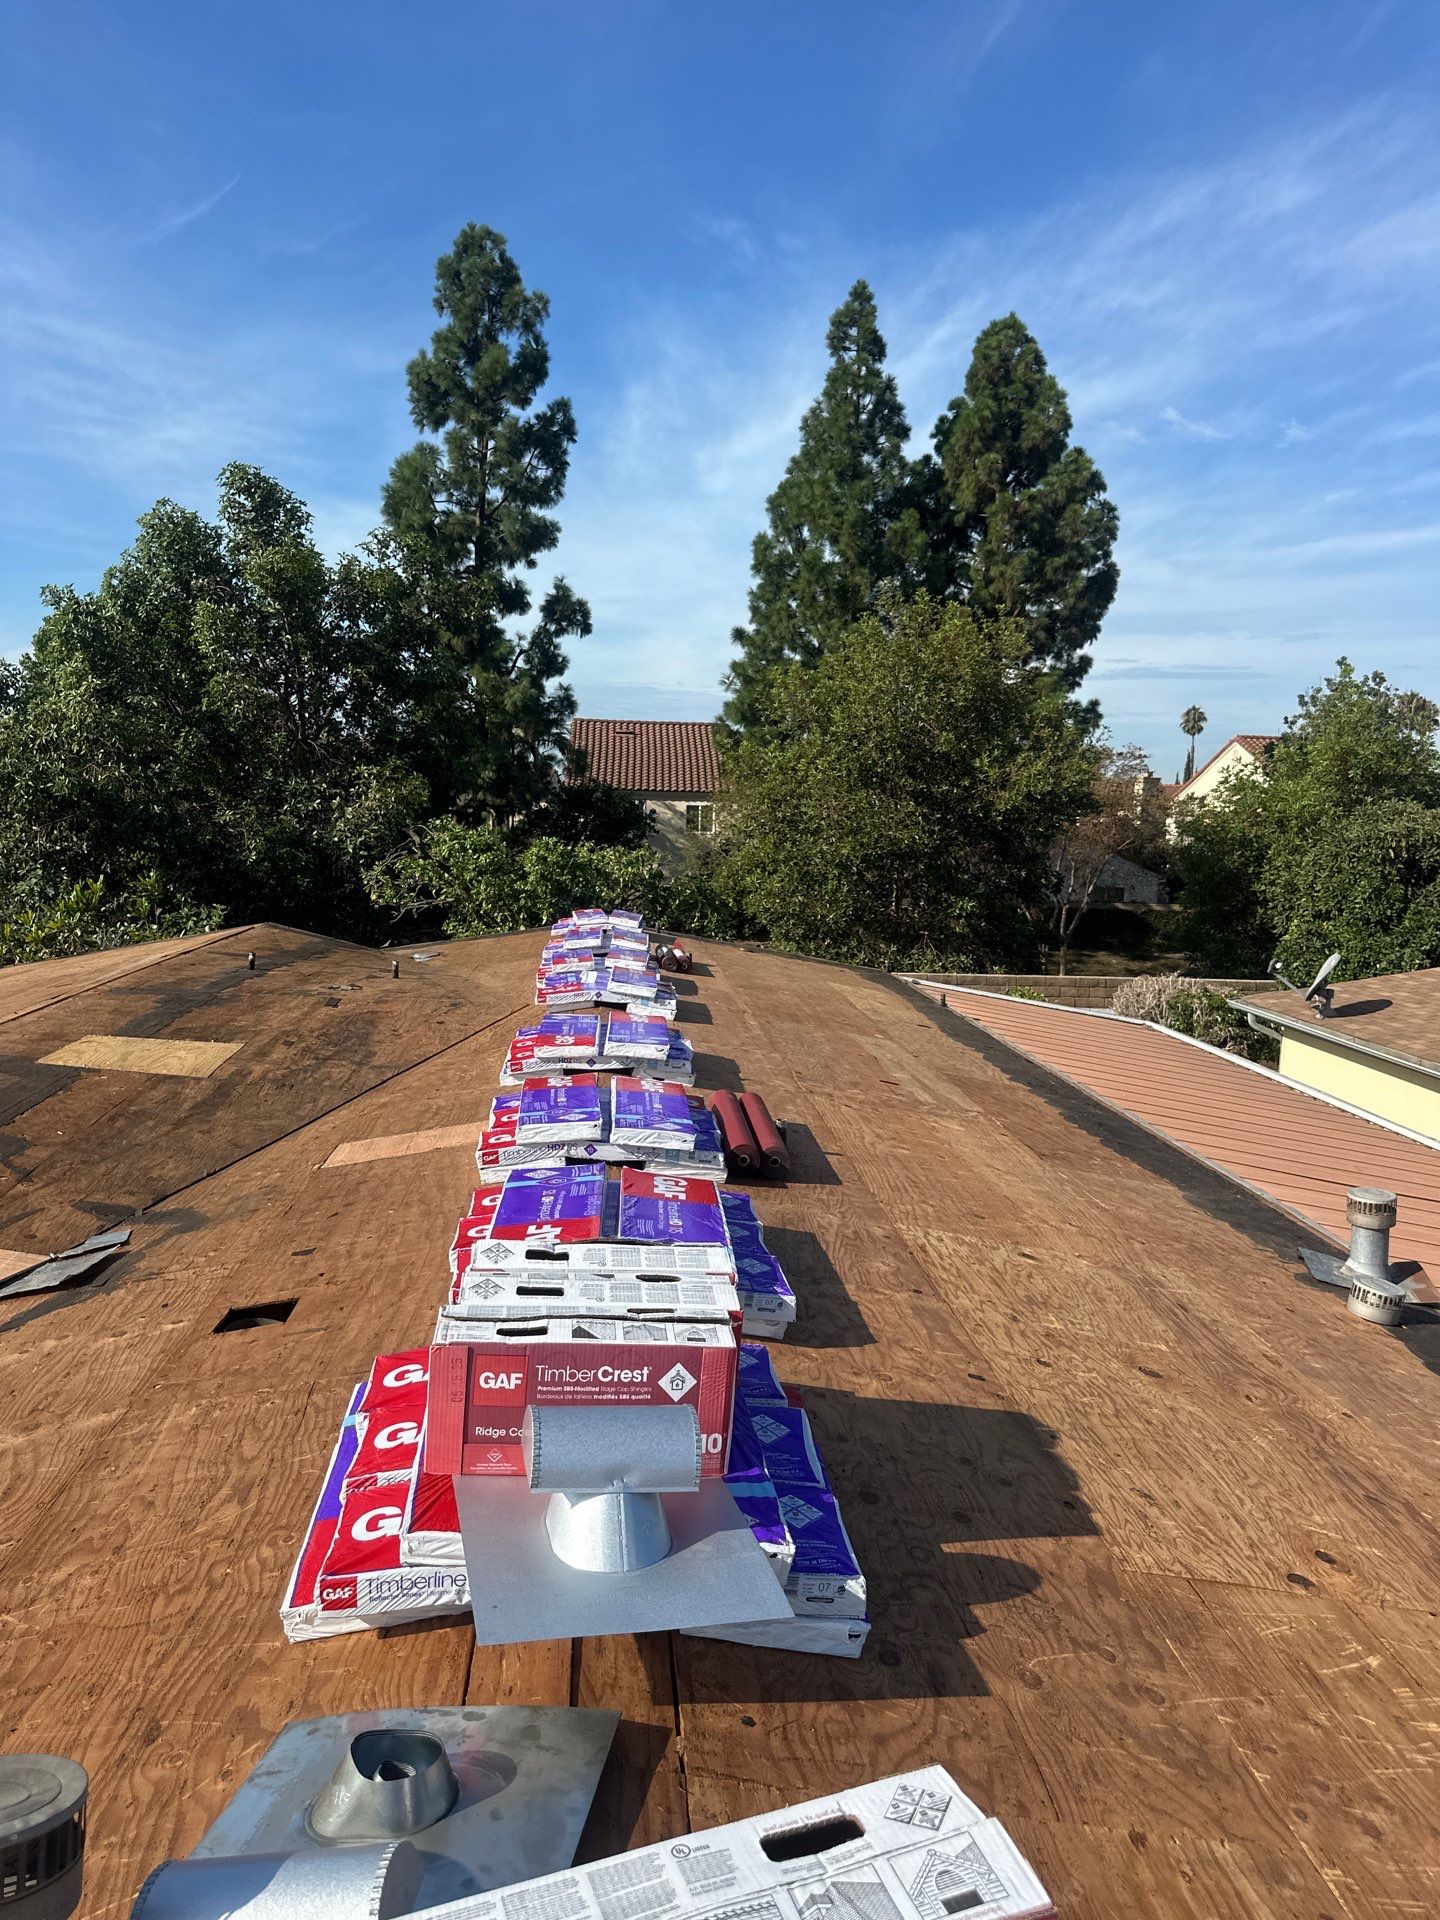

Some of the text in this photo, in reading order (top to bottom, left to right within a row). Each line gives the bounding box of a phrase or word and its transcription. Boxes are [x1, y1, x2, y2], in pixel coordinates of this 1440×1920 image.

[654, 1176, 688, 1200] GAF
[479, 1371, 524, 1389] GAF
[535, 1365, 649, 1382] TimberCrest
[475, 1427, 507, 1439] Ridge
[322, 1572, 467, 1600] GAF Timberline
[818, 1583, 831, 1592] 07
